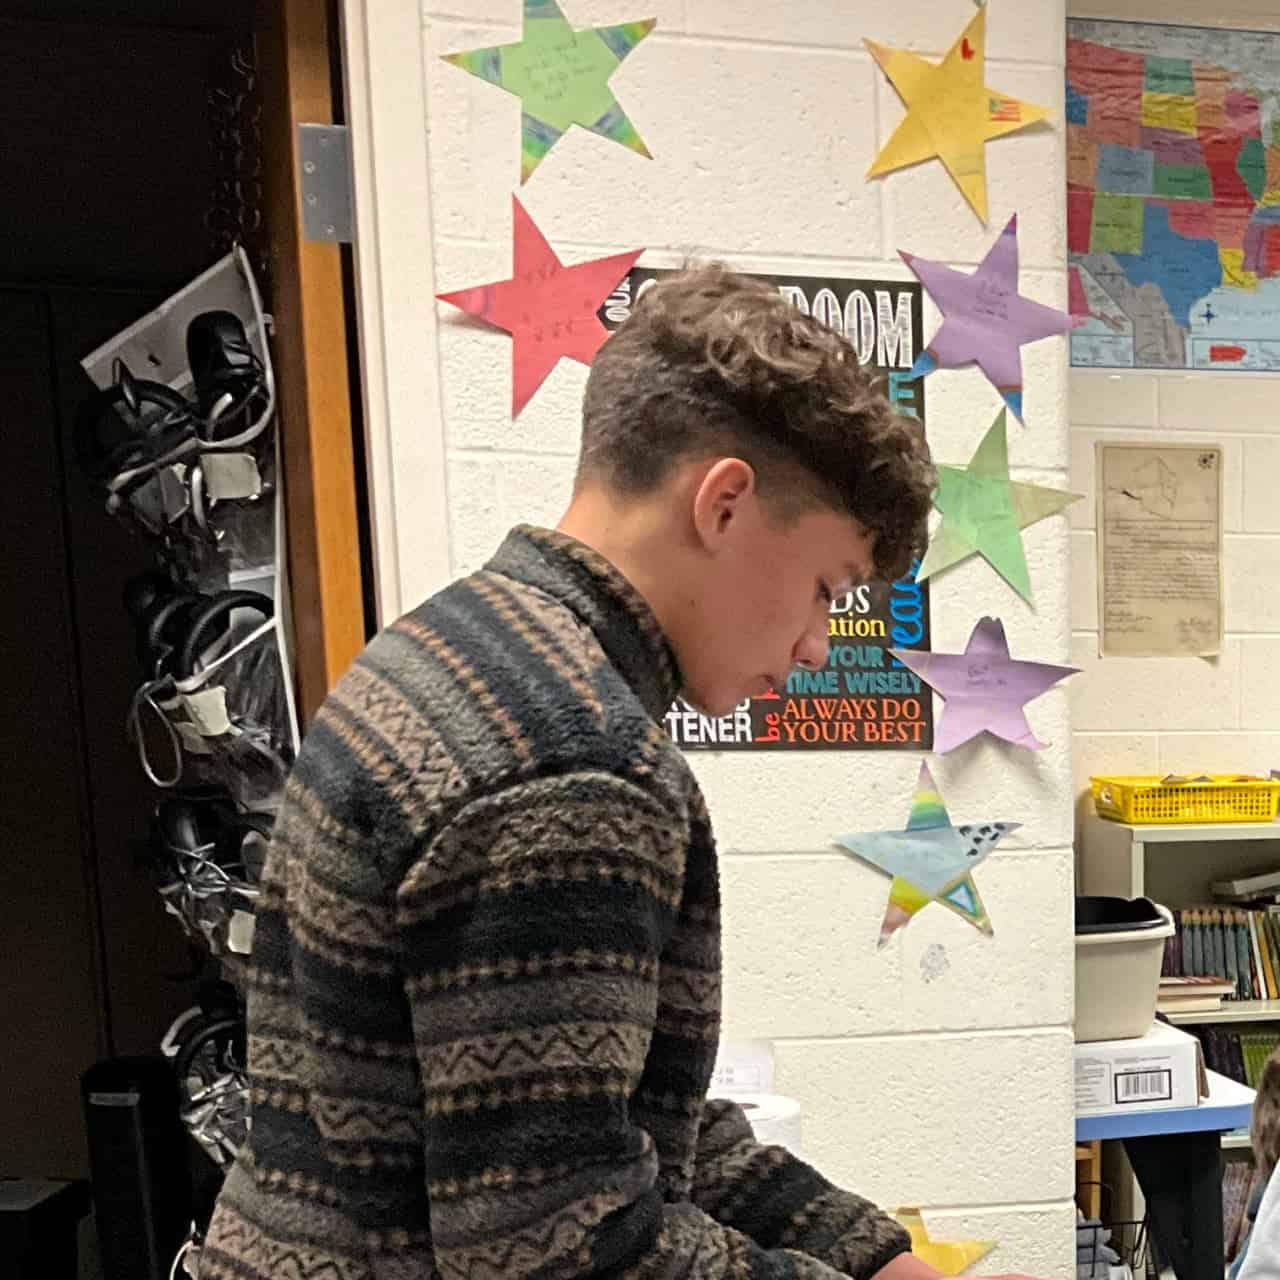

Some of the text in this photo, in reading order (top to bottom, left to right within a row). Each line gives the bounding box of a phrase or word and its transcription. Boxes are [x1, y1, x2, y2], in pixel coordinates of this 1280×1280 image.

[829, 646, 883, 668] YOUR
[845, 671, 922, 694] WISELY
[783, 698, 921, 721] ALWAYS DO
[783, 721, 926, 743] YOUR BEST
